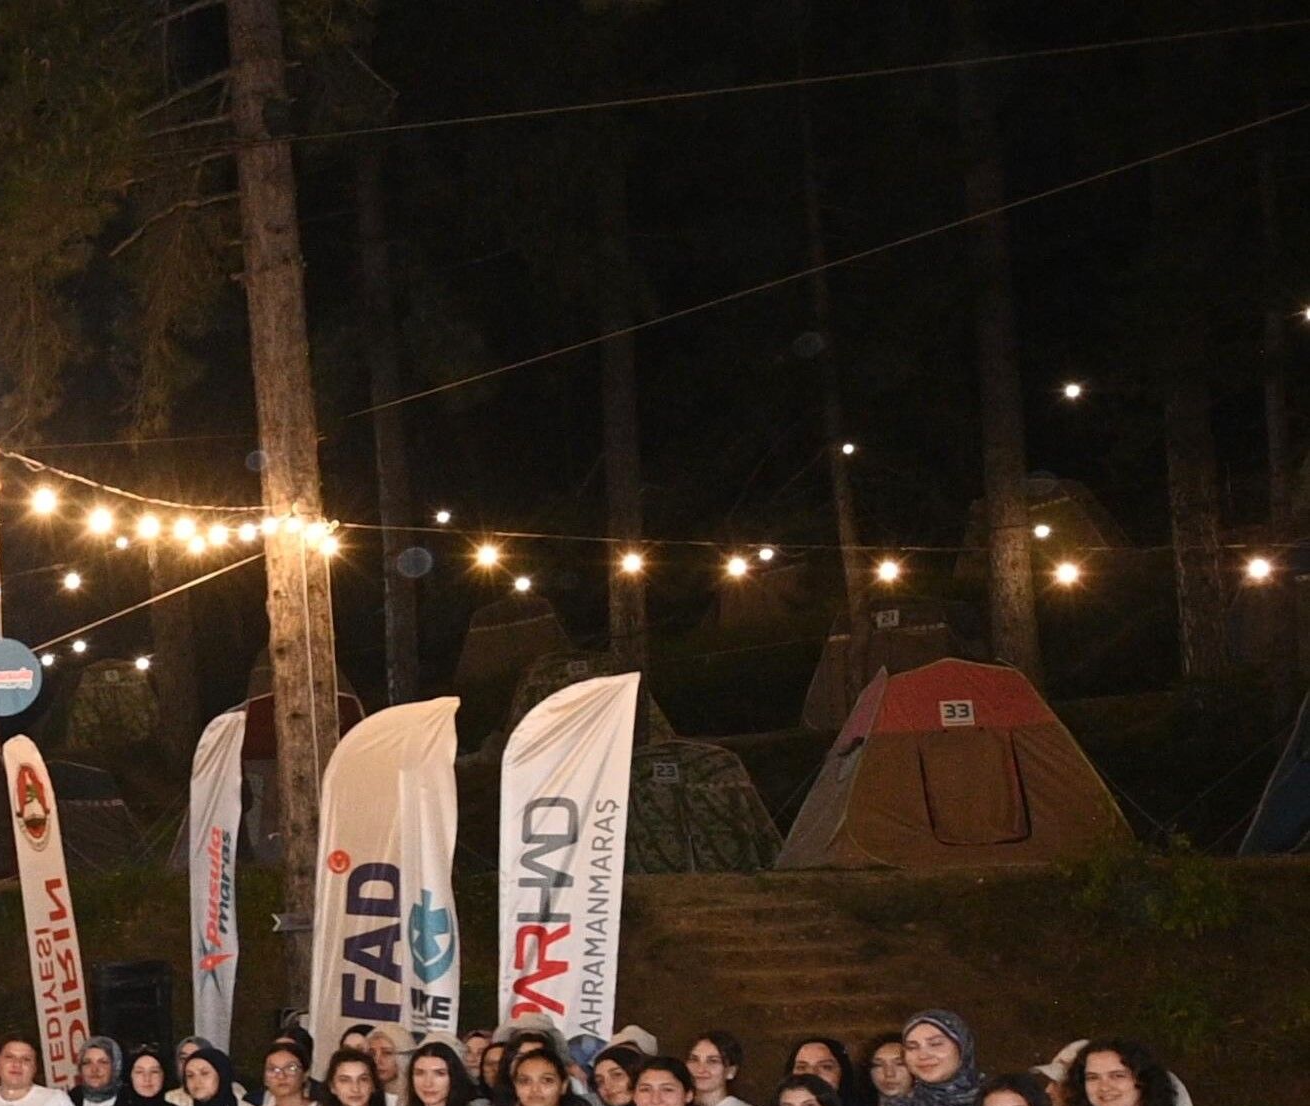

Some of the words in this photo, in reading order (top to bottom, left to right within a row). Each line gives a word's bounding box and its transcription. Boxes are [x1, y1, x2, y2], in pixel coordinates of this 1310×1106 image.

[943, 702, 970, 719] 33
[656, 765, 676, 778] 23
[207, 826, 223, 947] pusula
[579, 799, 620, 1036] AHRAMANMARAŞ
